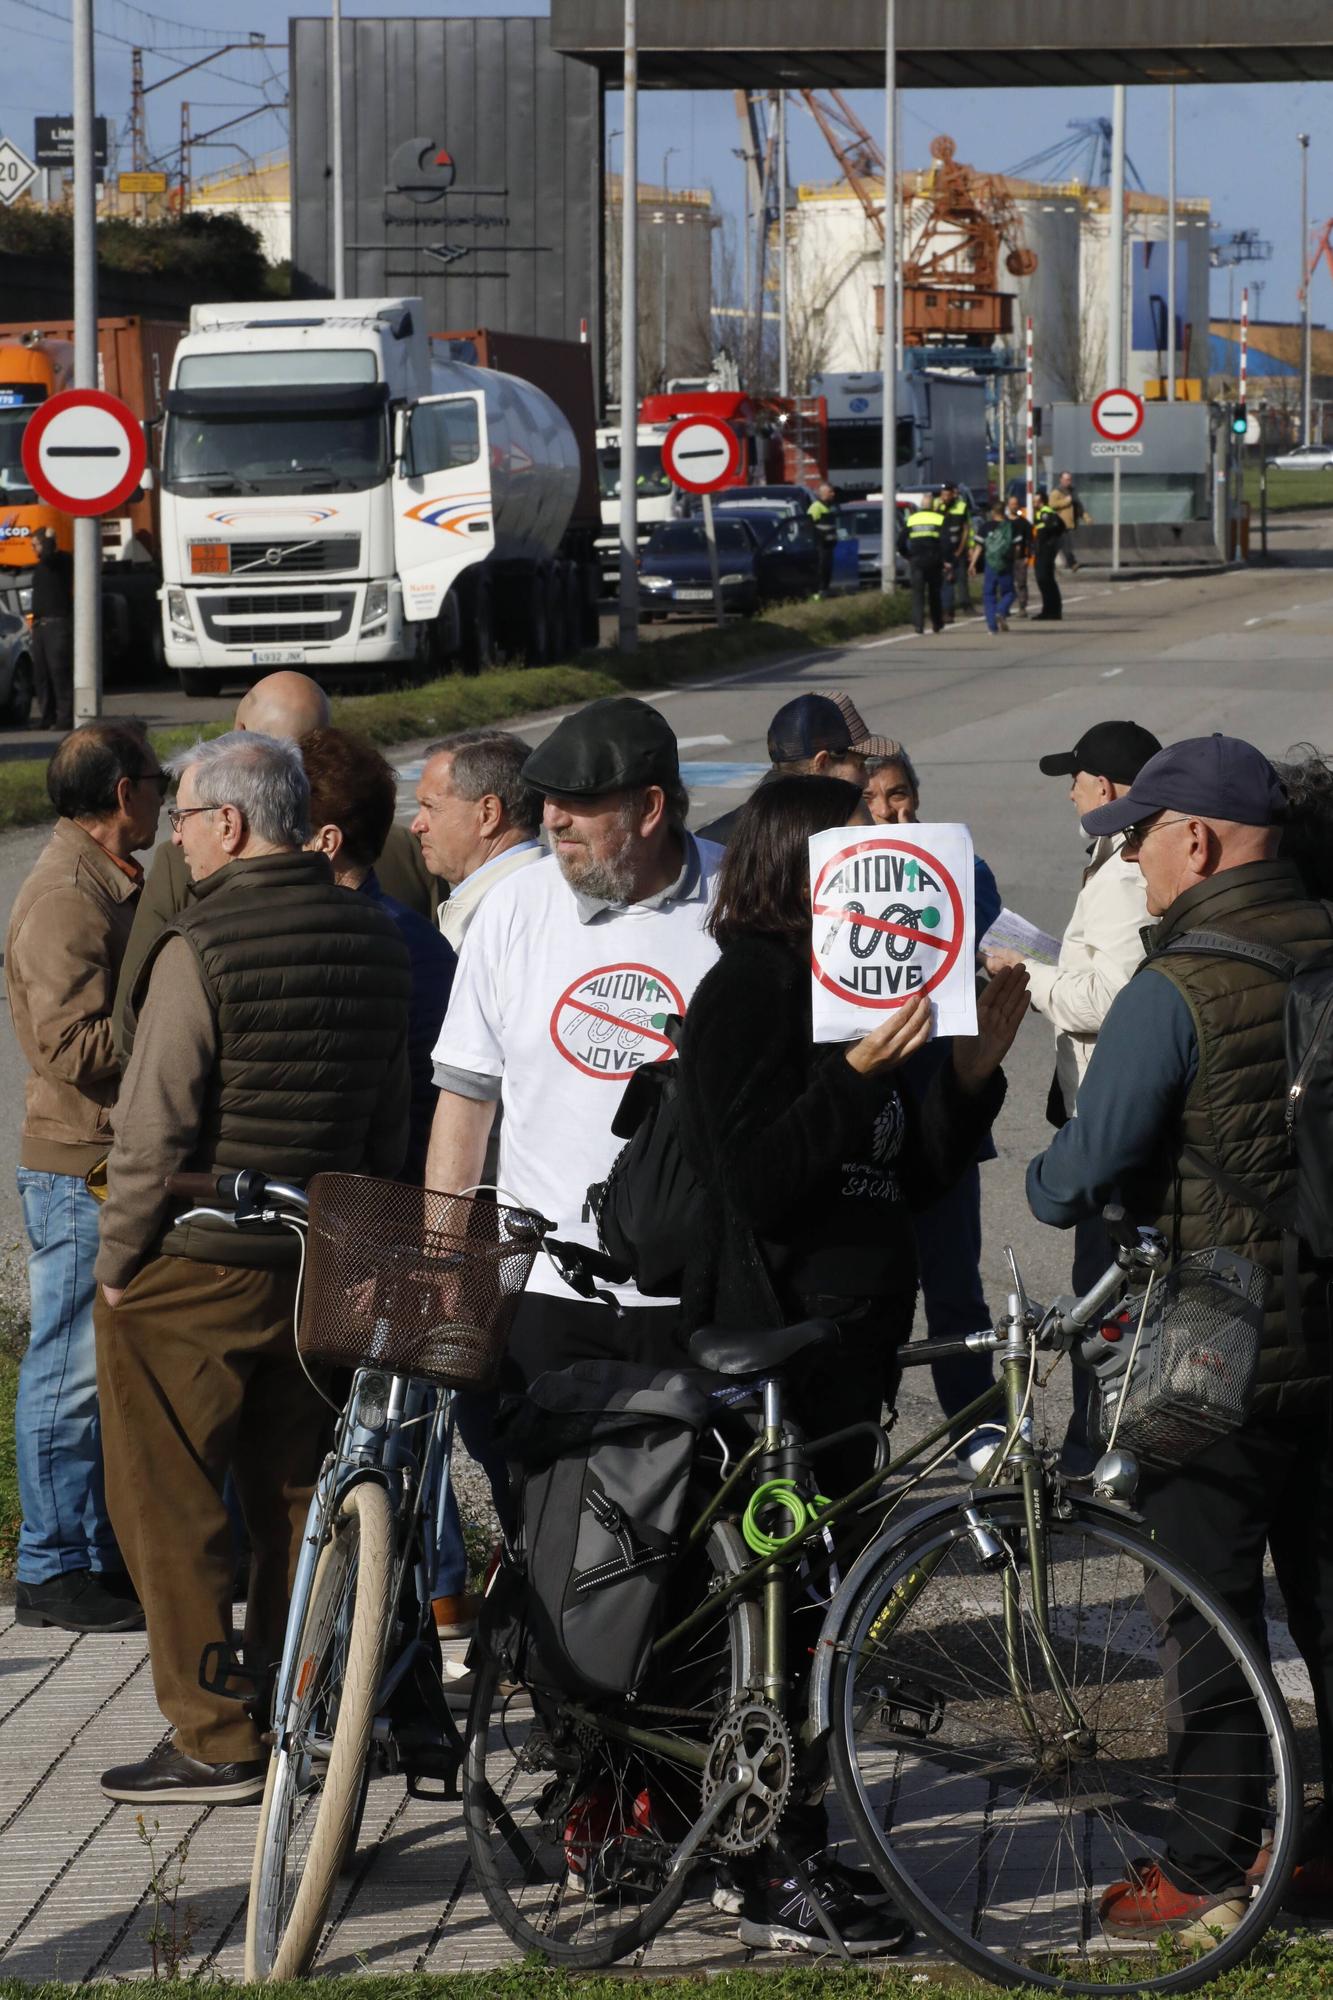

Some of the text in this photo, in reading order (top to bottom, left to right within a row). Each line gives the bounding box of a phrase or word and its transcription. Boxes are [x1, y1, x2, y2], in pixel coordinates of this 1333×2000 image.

[1092, 444, 1142, 453] CONTROL
[839, 965, 923, 995] JOVE
[577, 1046, 645, 1070] JOVE
